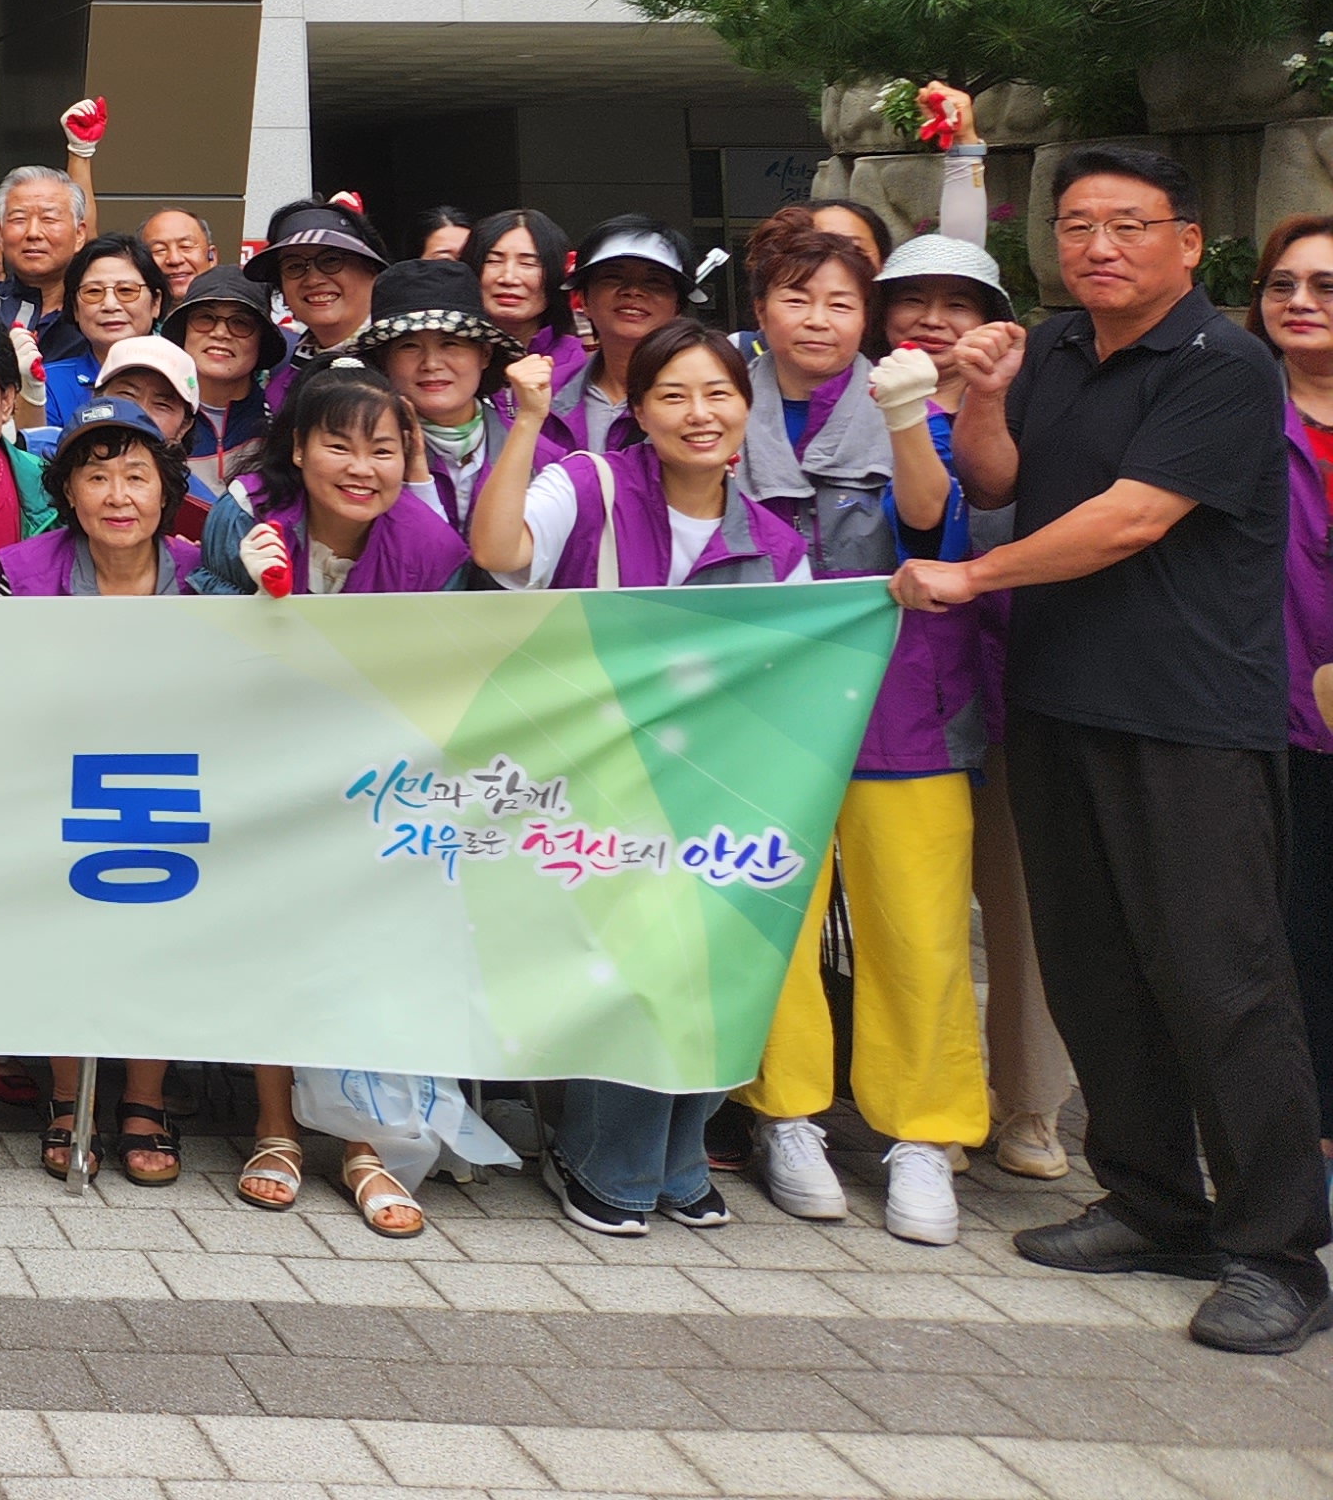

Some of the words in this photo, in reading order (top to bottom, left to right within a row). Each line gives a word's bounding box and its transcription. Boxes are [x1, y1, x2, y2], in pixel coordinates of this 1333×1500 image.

[345, 759, 473, 823] 시민과
[381, 823, 508, 882] 자유로운
[521, 823, 669, 885] 혁신도시
[682, 834, 800, 883] 안산
